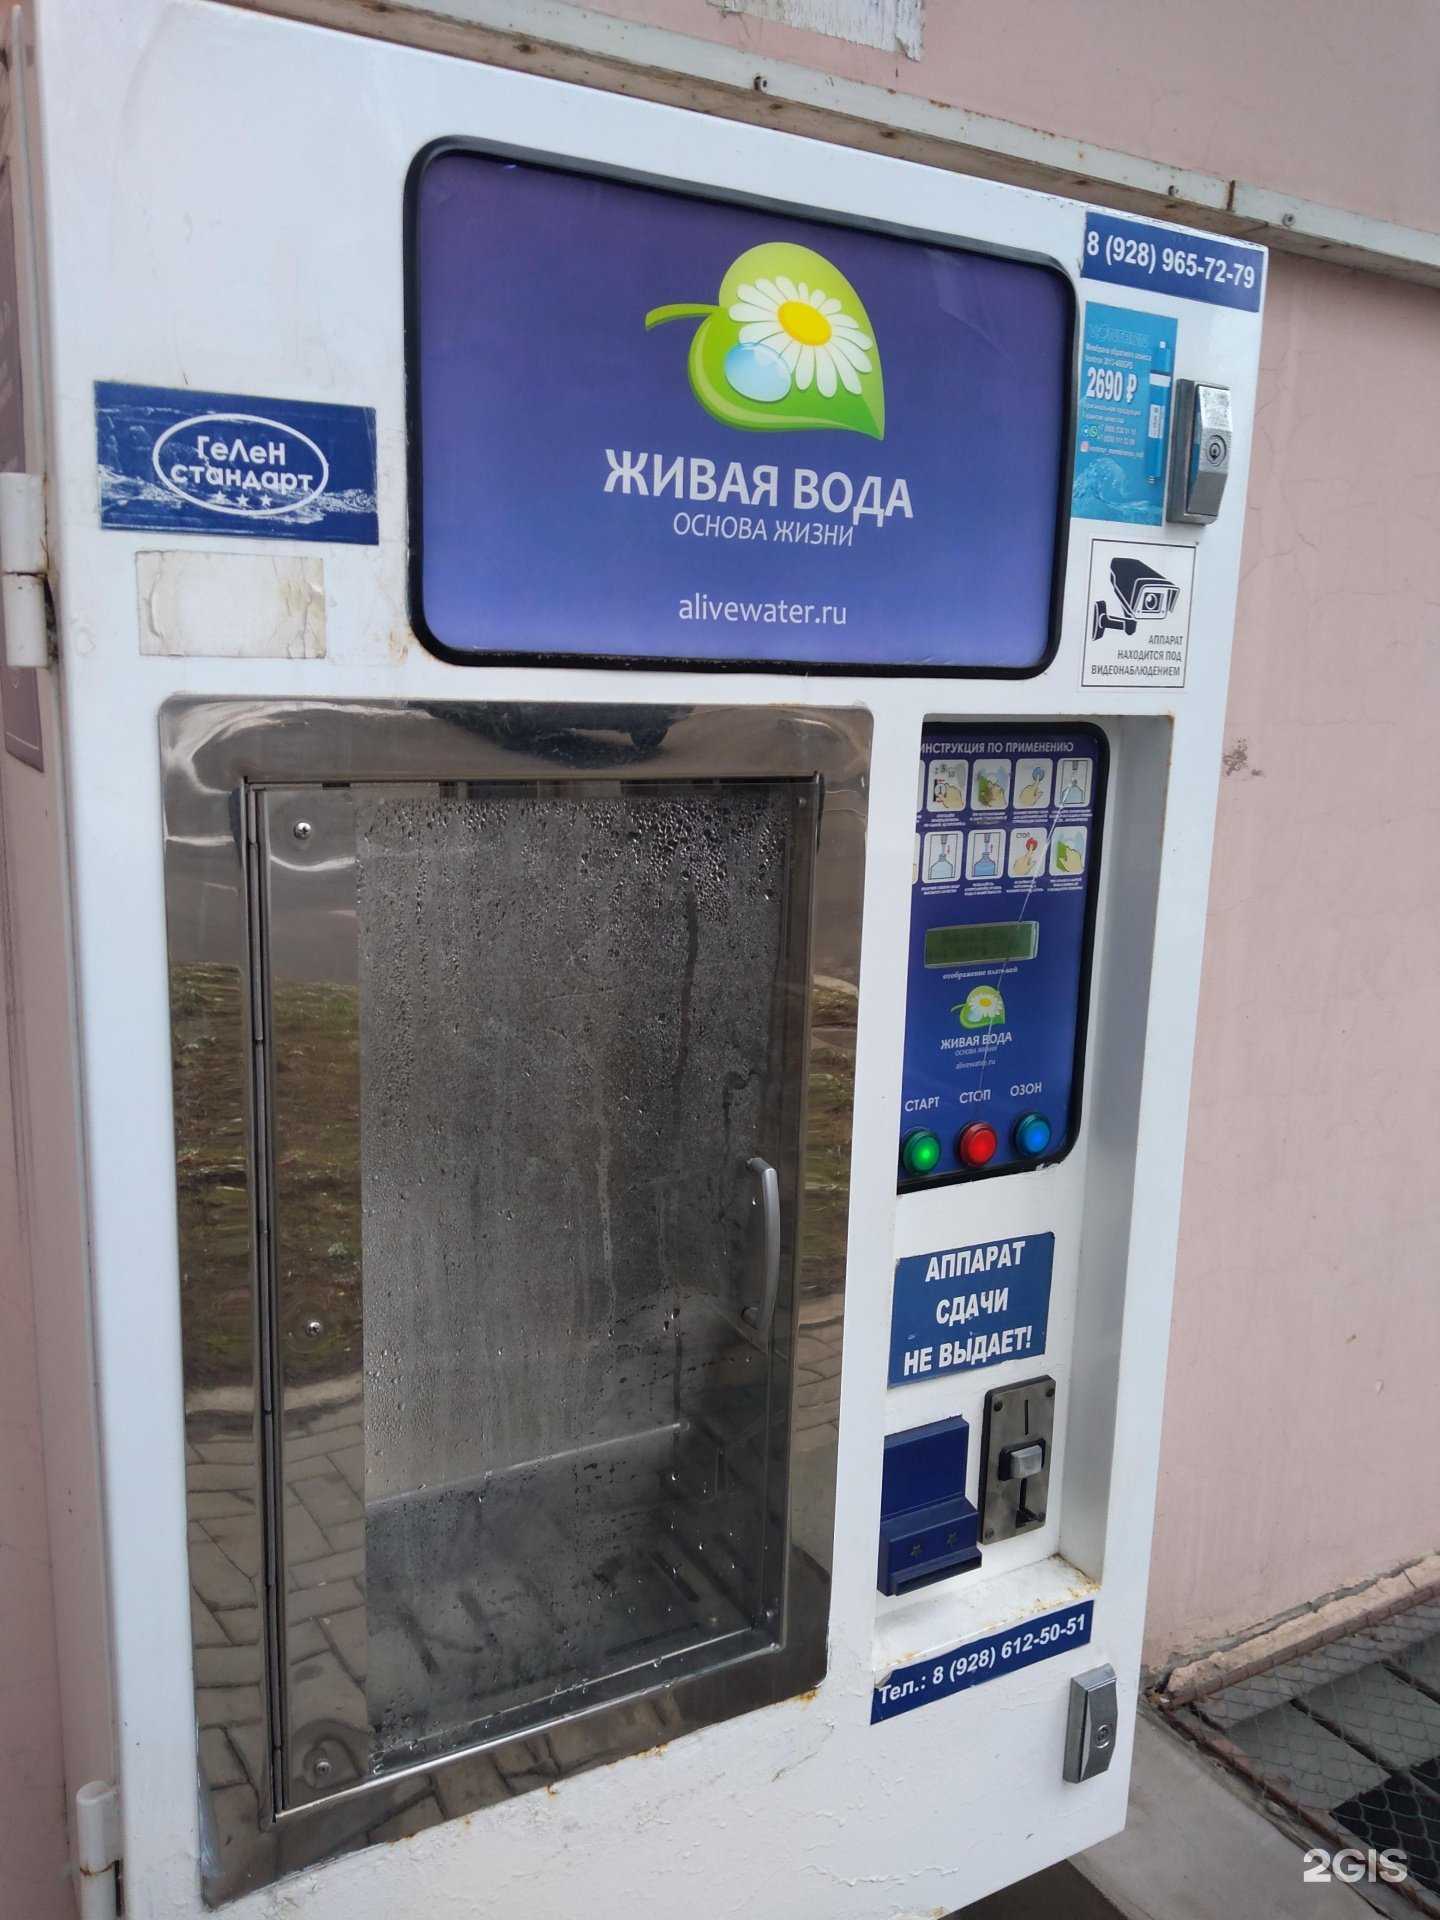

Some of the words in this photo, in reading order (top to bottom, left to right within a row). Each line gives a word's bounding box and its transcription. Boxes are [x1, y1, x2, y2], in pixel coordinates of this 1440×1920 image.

[1086, 231, 1100, 256] 8
[1105, 234, 1156, 274] (928)
[1162, 249, 1255, 289] 965-72-79
[1087, 367, 1123, 402] 2690
[604, 449, 778, 507] ЖИВАЯ
[794, 468, 914, 527] ВОДА
[673, 512, 768, 540] ОСНОВА
[773, 520, 854, 547] ЖИЗНИ
[679, 592, 847, 625] alivewater.ru
[1117, 650, 1164, 661] НАХОДИТСЯ
[1166, 651, 1182, 662] ПОД
[1148, 634, 1183, 646] АППАРАТ
[1091, 665, 1180, 677] ВИДЕОНАБЛЮДЕНИЕМ
[988, 742, 1003, 753] ПО
[1006, 741, 1074, 753] ПРИМЕНЕНИЮ
[940, 1035, 980, 1050] ЖИВАЯ
[982, 1032, 1012, 1045] ВОДА
[904, 1096, 940, 1112] СТАРТ
[959, 1090, 991, 1104] СТОП
[1010, 1082, 1042, 1097] ОЗОН
[925, 1241, 1026, 1282] АППАРАТ
[936, 1288, 1009, 1327] СДАЧИ
[904, 1346, 933, 1376] НЕ
[938, 1326, 1032, 1365] ВЫДАЕТ!
[878, 1675, 926, 1704] Тел.:
[932, 1666, 944, 1685] 8
[950, 1647, 996, 1682] (928)
[1001, 1614, 1085, 1659] 612-50-51
